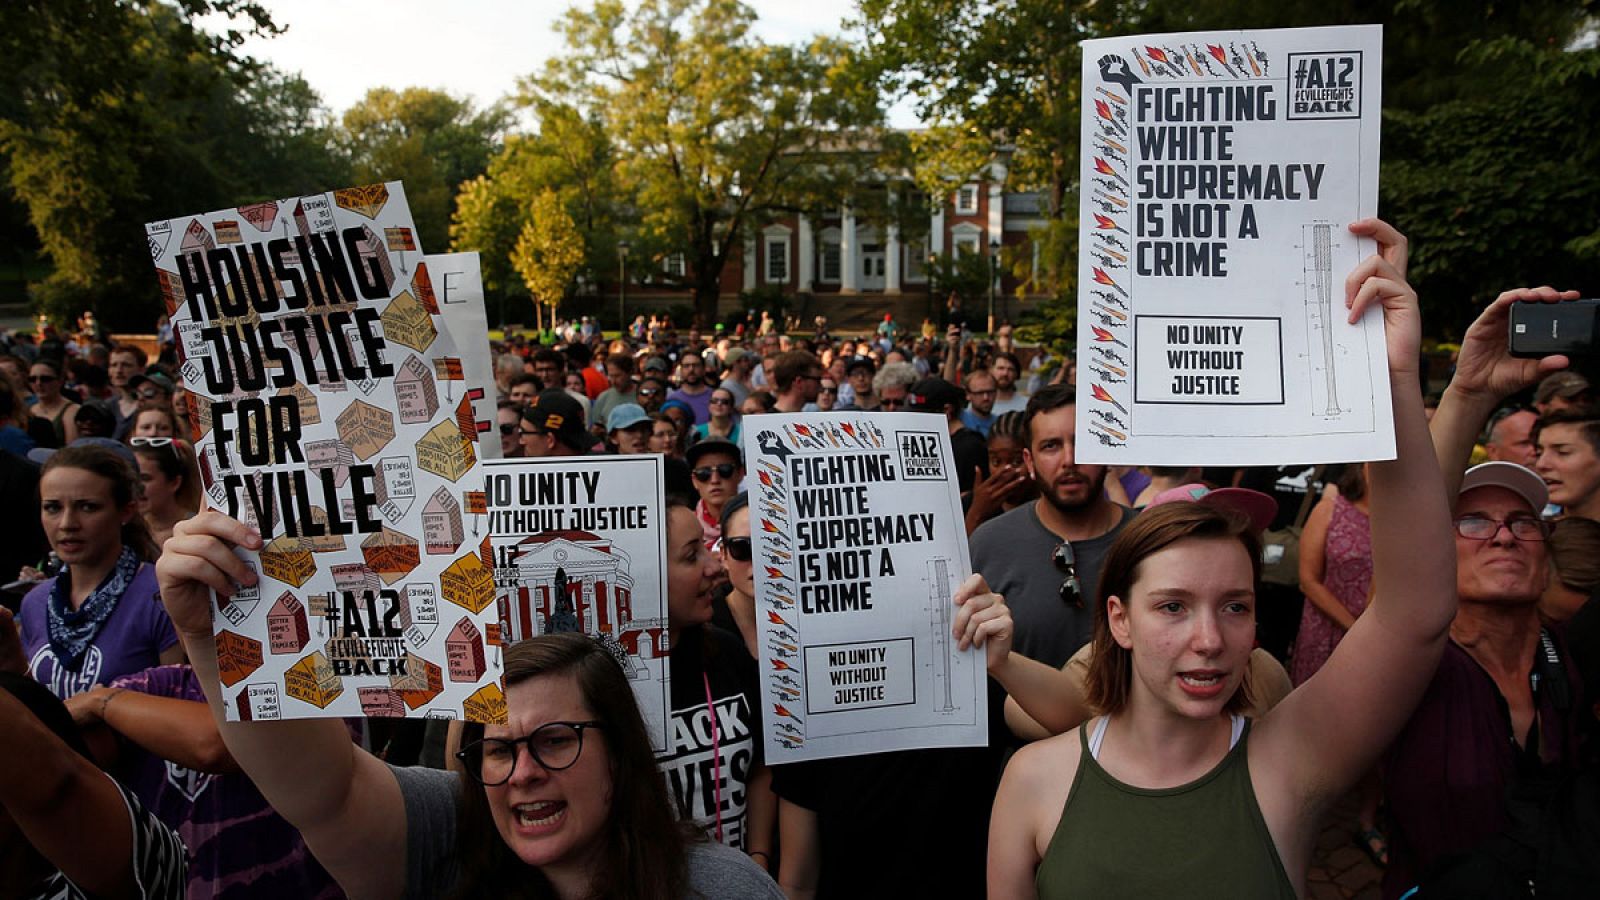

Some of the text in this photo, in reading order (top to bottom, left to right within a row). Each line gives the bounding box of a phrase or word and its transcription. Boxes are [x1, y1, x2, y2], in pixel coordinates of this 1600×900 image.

[1295, 58, 1354, 88] #A12
[1137, 85, 1276, 122] FIGHTING
[1294, 100, 1354, 113] BACK
[1295, 87, 1354, 101] #CVILLEFIGHTS
[1137, 125, 1233, 161] WHITE
[1137, 163, 1325, 200] SUPREMACY
[1137, 203, 1259, 239] IS NOT A
[175, 227, 391, 322] HOUSING
[1137, 242, 1228, 277] CRIME
[201, 307, 394, 395] JUSTICE
[1167, 325, 1243, 345] NO UNITY
[1167, 351, 1244, 370] WITHOUT
[1171, 375, 1240, 395] JUSTICE
[211, 395, 304, 469] FOR
[902, 435, 938, 458] #A12
[791, 454, 895, 487] FIGHTING
[906, 467, 942, 477] BACK
[519, 471, 600, 506] UNITY
[793, 486, 870, 519] WHITE
[487, 505, 648, 534] ITHOUT JUSTICE
[796, 513, 936, 551] SUPREMACY
[799, 547, 895, 583] IS NOT A
[325, 589, 402, 639] #A12
[801, 581, 873, 614] CRIME
[331, 639, 407, 658] #CVILLEFIGHTS
[829, 648, 886, 666] NO UNITY
[332, 658, 408, 677] BACK
[830, 666, 887, 686] WITHOUT
[834, 685, 885, 705] JUSTICE
